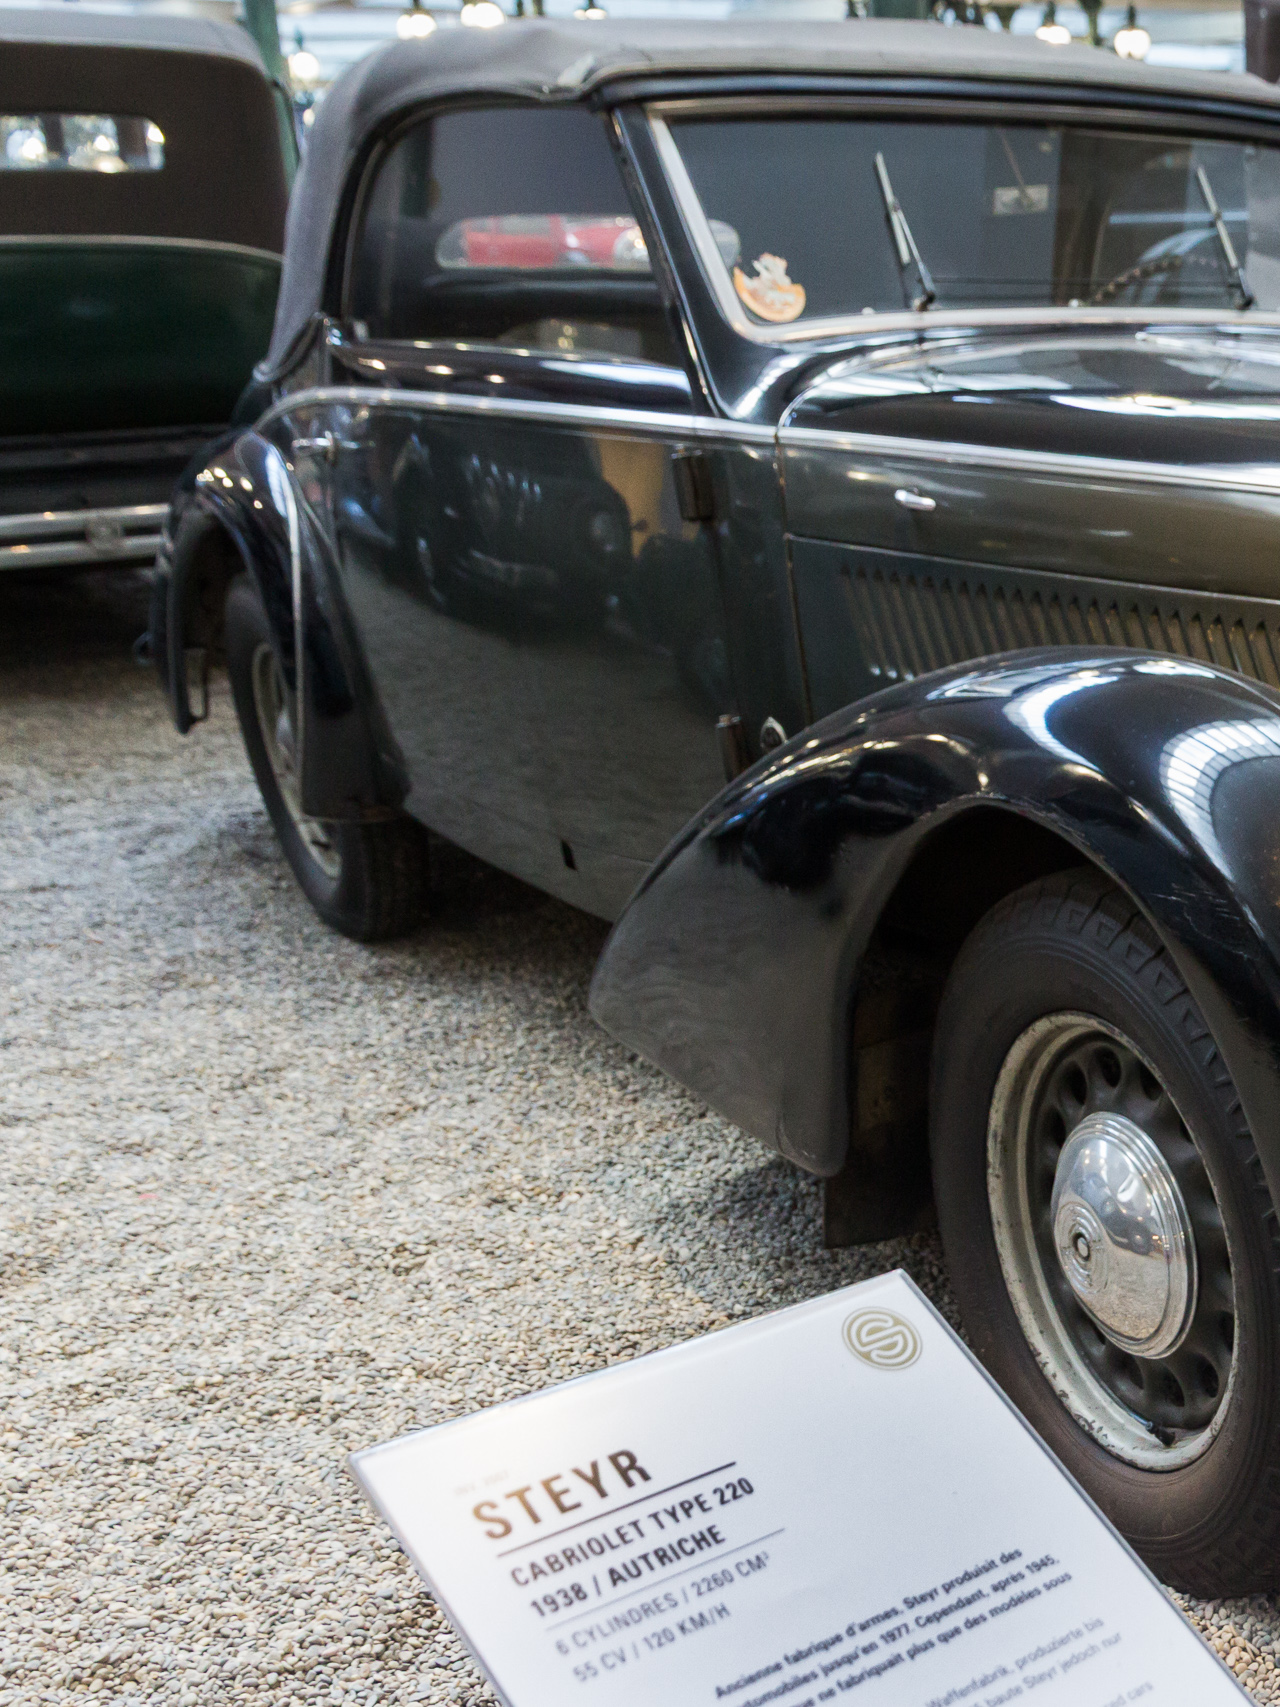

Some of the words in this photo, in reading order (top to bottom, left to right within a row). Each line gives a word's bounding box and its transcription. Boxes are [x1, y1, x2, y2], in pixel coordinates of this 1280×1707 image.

[472, 1449, 651, 1540] STEYR
[510, 1519, 646, 1587] CABRIOLET
[648, 1494, 714, 1532] TYPE
[713, 1476, 755, 1507] 220
[530, 1580, 587, 1618] 1938
[593, 1575, 602, 1598] /
[607, 1524, 726, 1587] AUTRICHE
[555, 1638, 570, 1655] 6
[571, 1591, 679, 1651] CYLINDRES
[682, 1585, 690, 1604] /
[691, 1567, 735, 1598] 2260
[906, 1637, 935, 1660] plus
[937, 1626, 962, 1643] que
[964, 1613, 987, 1630] des
[1043, 1572, 1072, 1591] sous
[572, 1661, 599, 1683] 55
[601, 1647, 627, 1671] CV
[633, 1639, 640, 1659] /
[642, 1627, 676, 1652] 120
[677, 1601, 731, 1636] KM/H
[716, 1662, 782, 1698] Ancienne
[784, 1633, 843, 1665] fabrique
[903, 1588, 939, 1610] Steyr
[941, 1559, 998, 1594] produisit
[1000, 1549, 1022, 1564] des
